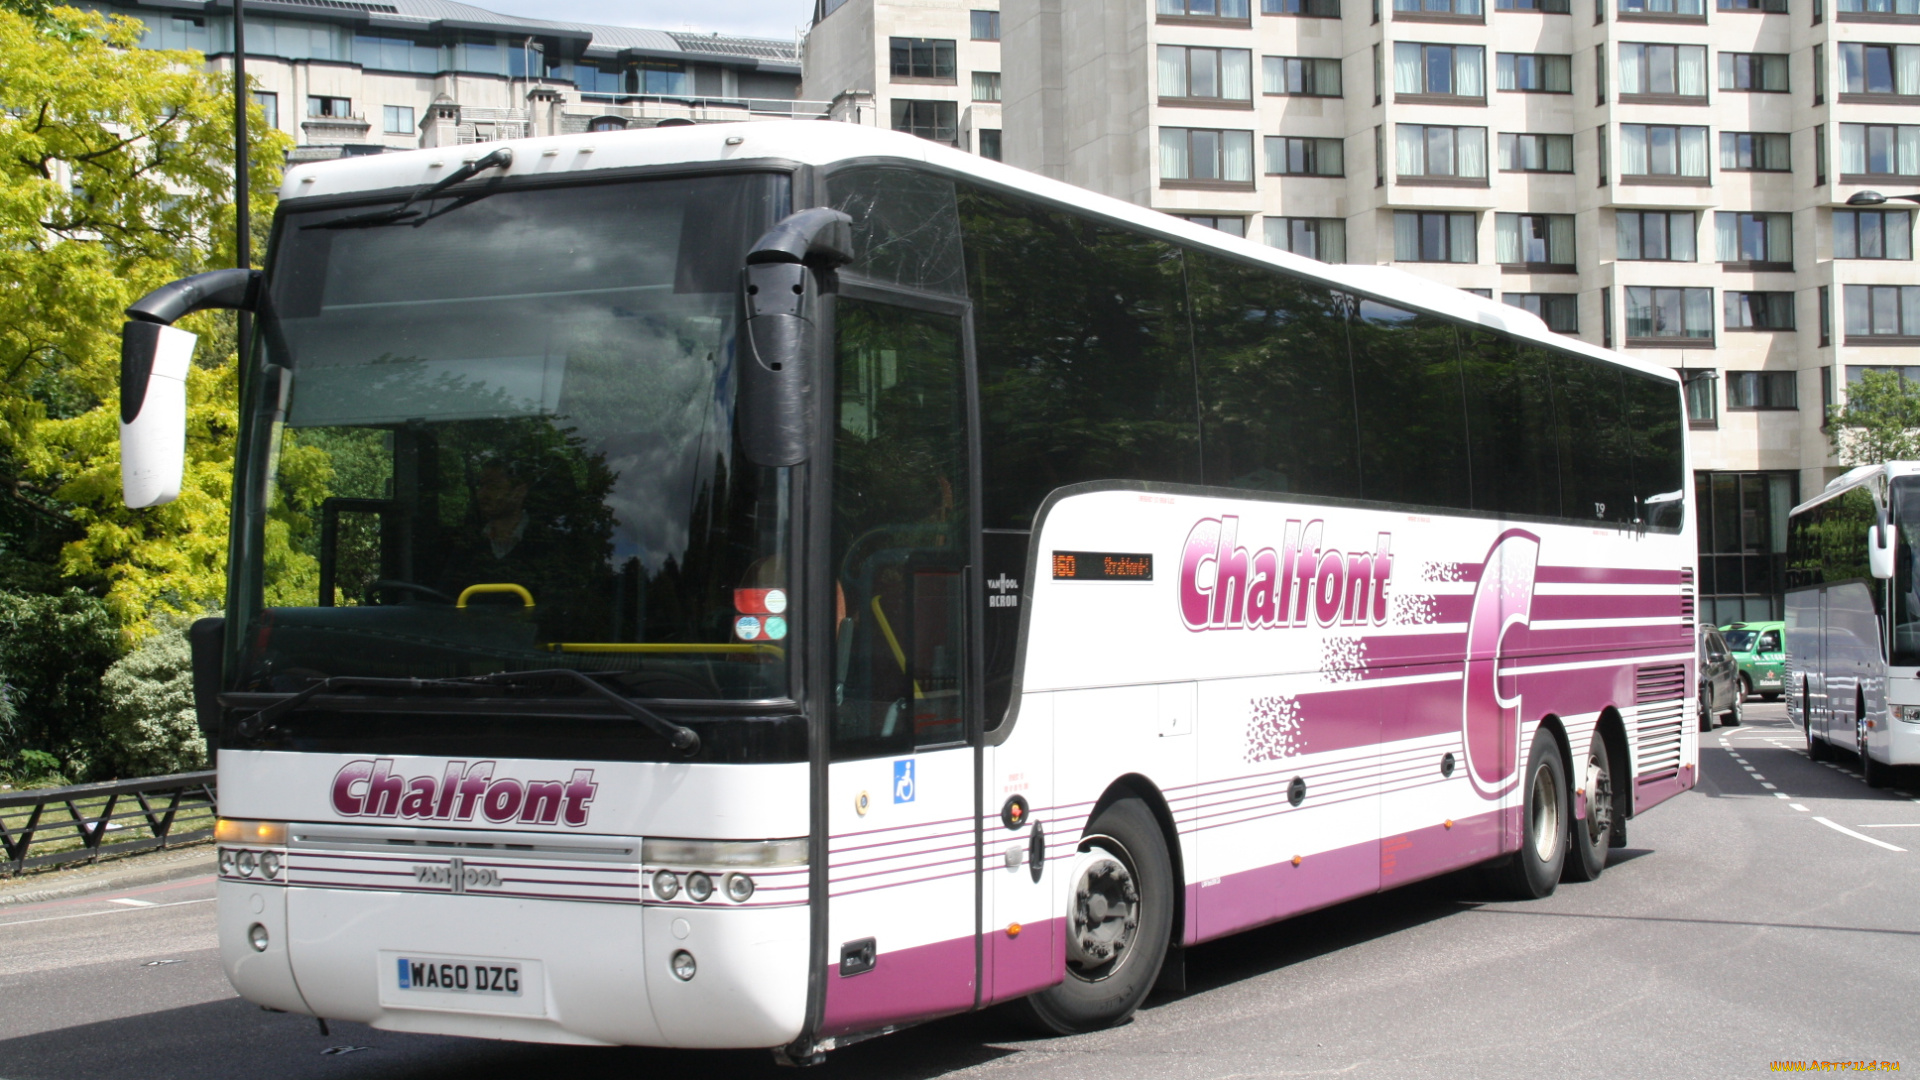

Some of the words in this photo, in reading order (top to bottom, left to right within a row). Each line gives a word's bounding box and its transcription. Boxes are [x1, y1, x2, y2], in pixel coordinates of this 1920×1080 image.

[1594, 502, 1606, 514] T9
[1178, 514, 1394, 632] Chalfont
[989, 595, 1018, 608] ACRON
[330, 758, 599, 827] Chalfont
[411, 962, 468, 990] WA60
[475, 965, 519, 992] DZG
